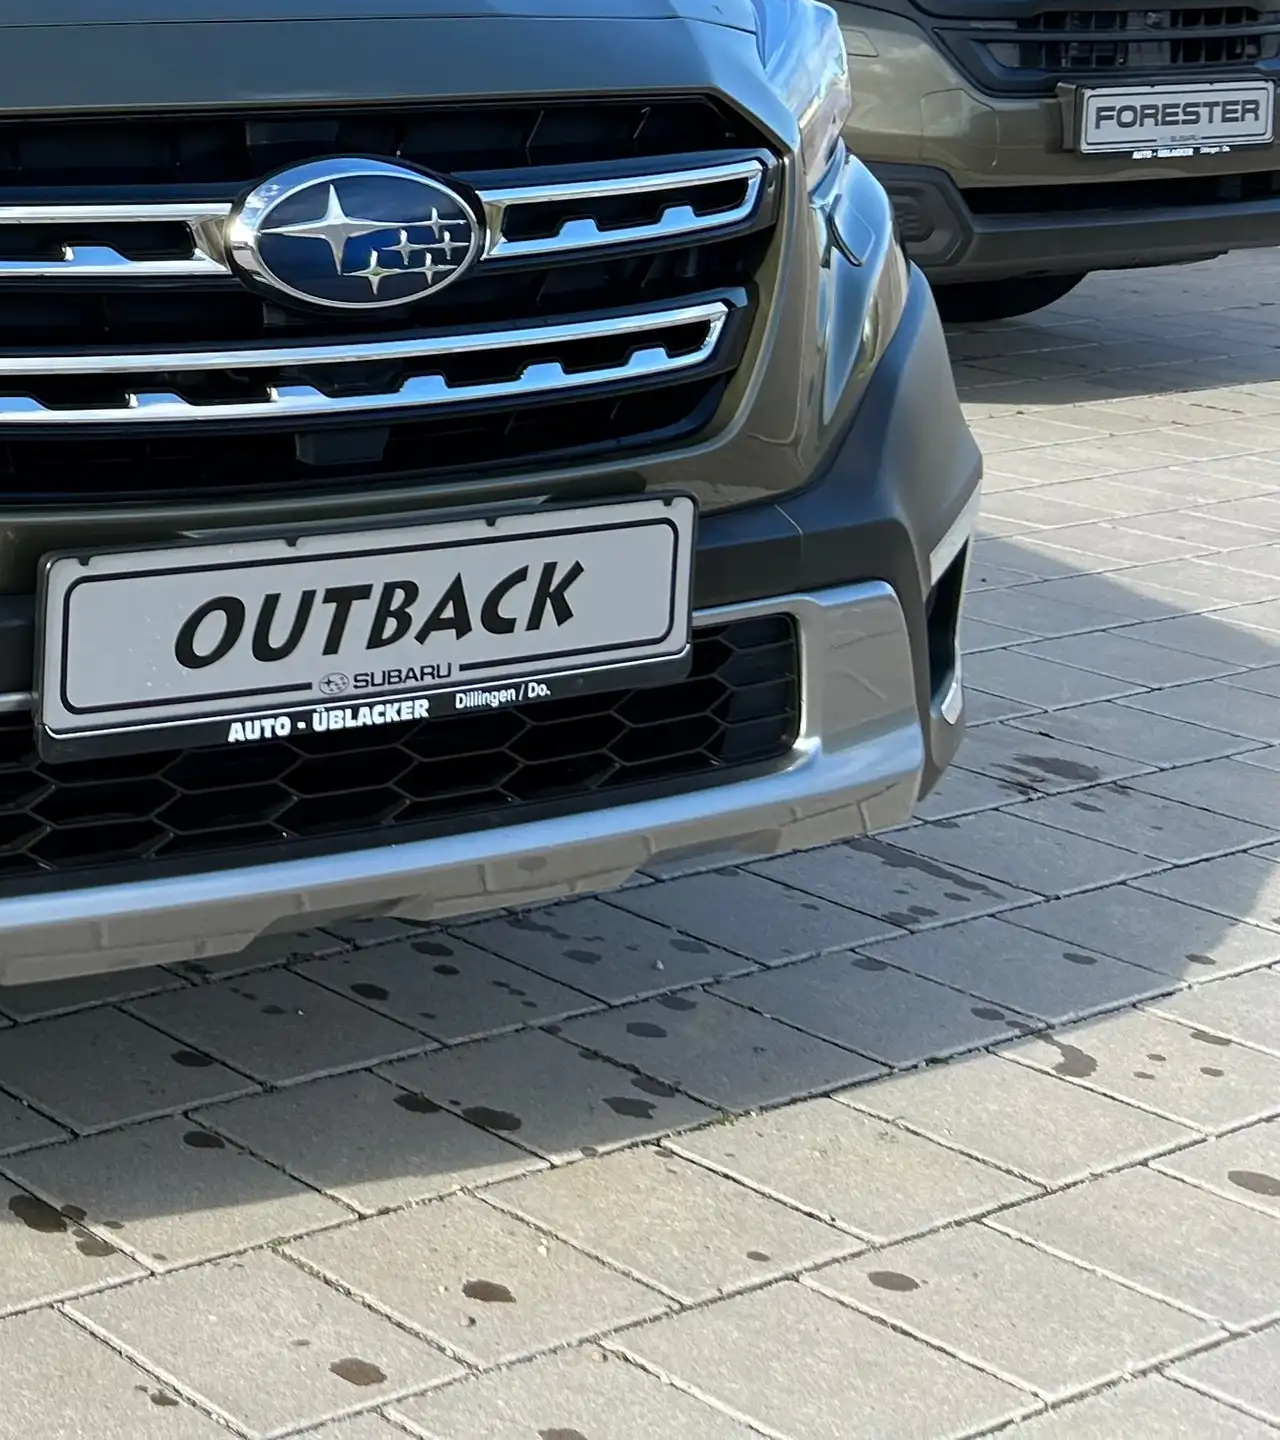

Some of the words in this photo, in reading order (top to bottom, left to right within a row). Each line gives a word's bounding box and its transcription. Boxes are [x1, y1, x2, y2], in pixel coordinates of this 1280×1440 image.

[1095, 100, 1260, 129] FORESTER
[174, 559, 585, 669] OUTBACK
[352, 662, 452, 689] SUBARU
[227, 717, 291, 743] AUTO
[312, 697, 430, 732] ÜBLACKER
[455, 685, 517, 710] Dillingen
[527, 681, 552, 699] Do.
